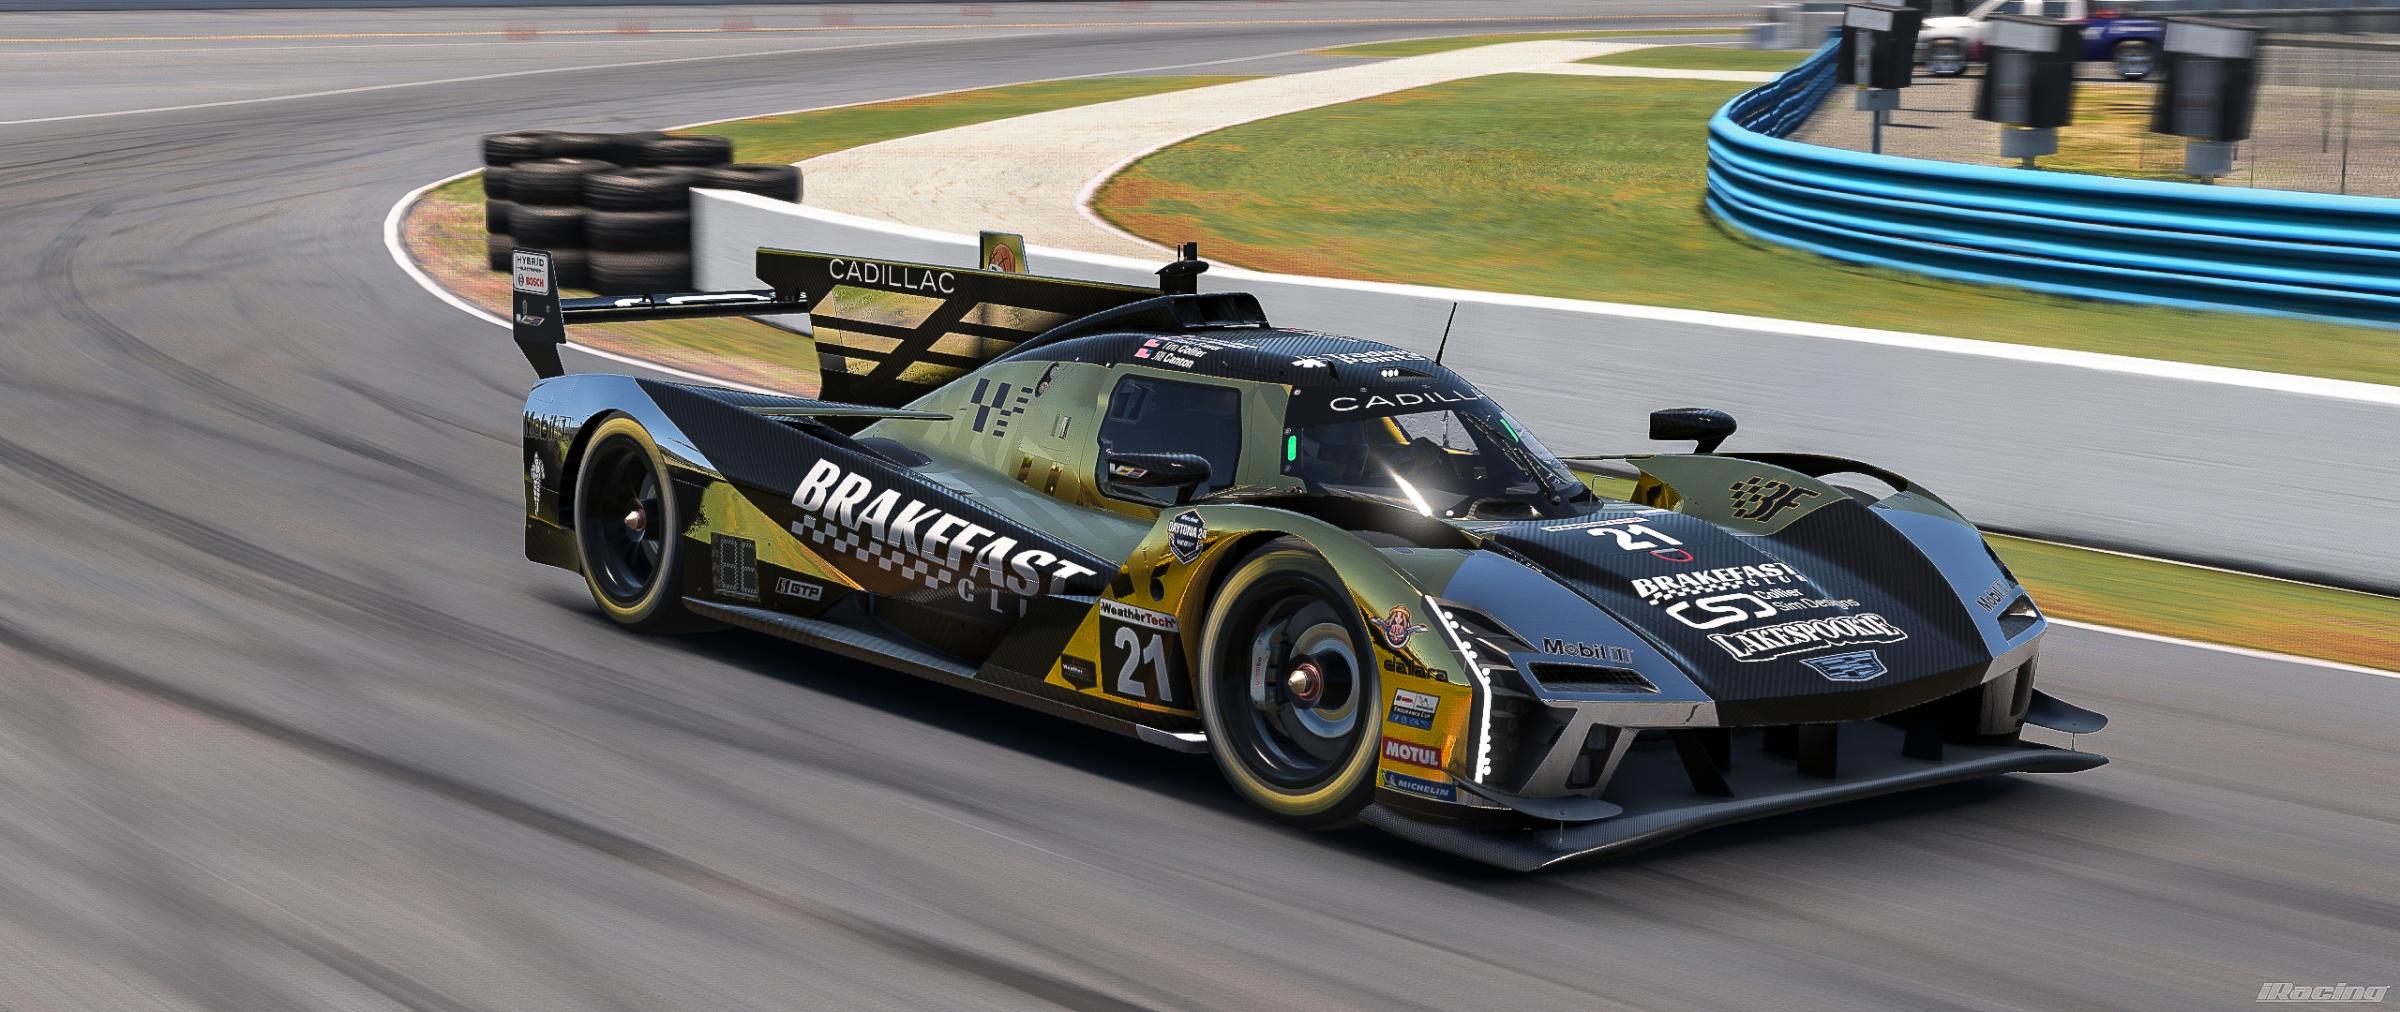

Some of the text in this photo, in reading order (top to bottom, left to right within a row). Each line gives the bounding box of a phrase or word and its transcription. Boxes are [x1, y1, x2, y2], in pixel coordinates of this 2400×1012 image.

[516, 256, 545, 267] HYBRID
[525, 276, 544, 288] BOSCH
[829, 258, 955, 294] CADILLAC
[1161, 341, 1179, 352] Tim
[1163, 352, 1195, 369] Canton
[791, 457, 1098, 597] BRAKEFAST
[1586, 524, 1684, 551] 21
[789, 582, 820, 597] GTP
[1630, 562, 1797, 599] BRAKEFAST
[1753, 587, 1804, 600] Collier
[1771, 600, 1807, 612] Sim
[1709, 613, 1904, 660] LAKESPOOKIE
[1542, 636, 1607, 661] Mobil
[1114, 626, 1173, 702] 21
[1386, 740, 1439, 766] MOTUL
[1398, 779, 1450, 797] MICHELIN
